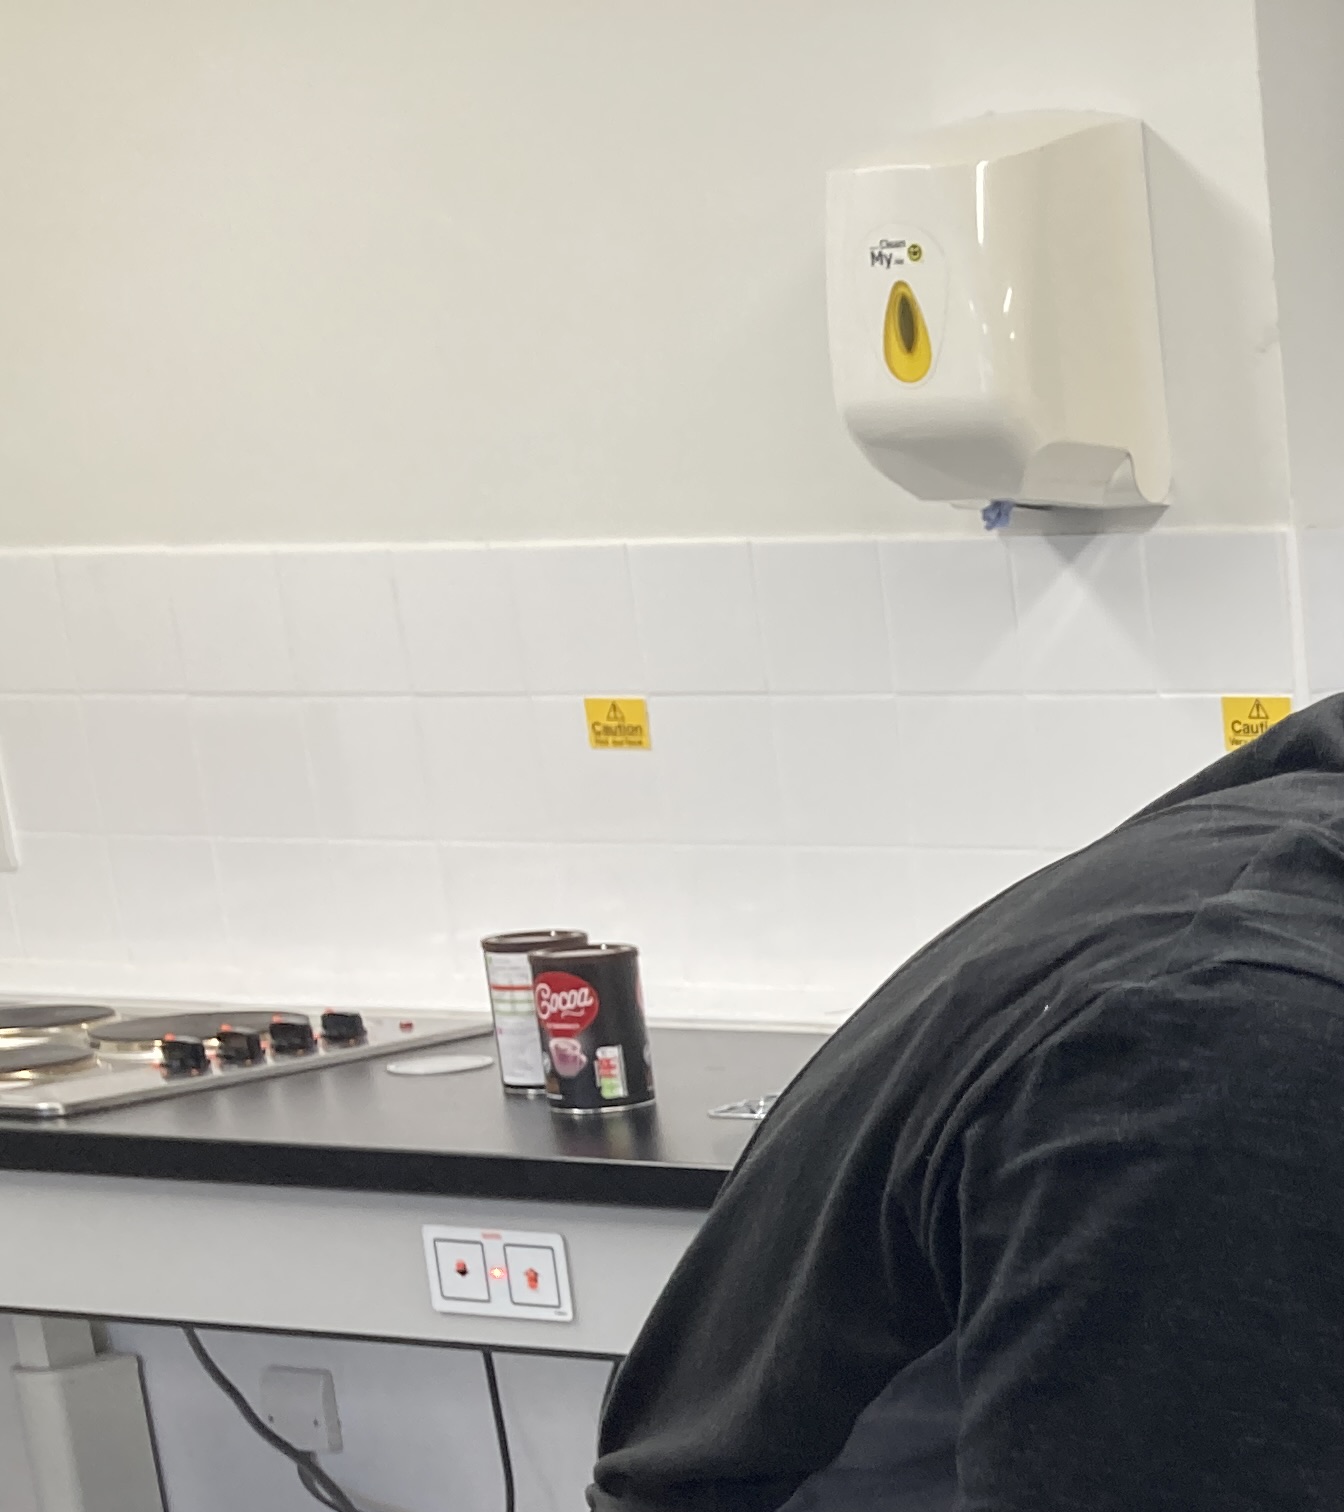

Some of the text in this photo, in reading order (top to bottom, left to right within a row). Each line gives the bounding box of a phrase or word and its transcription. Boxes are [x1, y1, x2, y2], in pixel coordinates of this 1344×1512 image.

[871, 251, 892, 269] My
[1231, 720, 1268, 735] Cauti
[535, 982, 594, 1020] Cocoa
